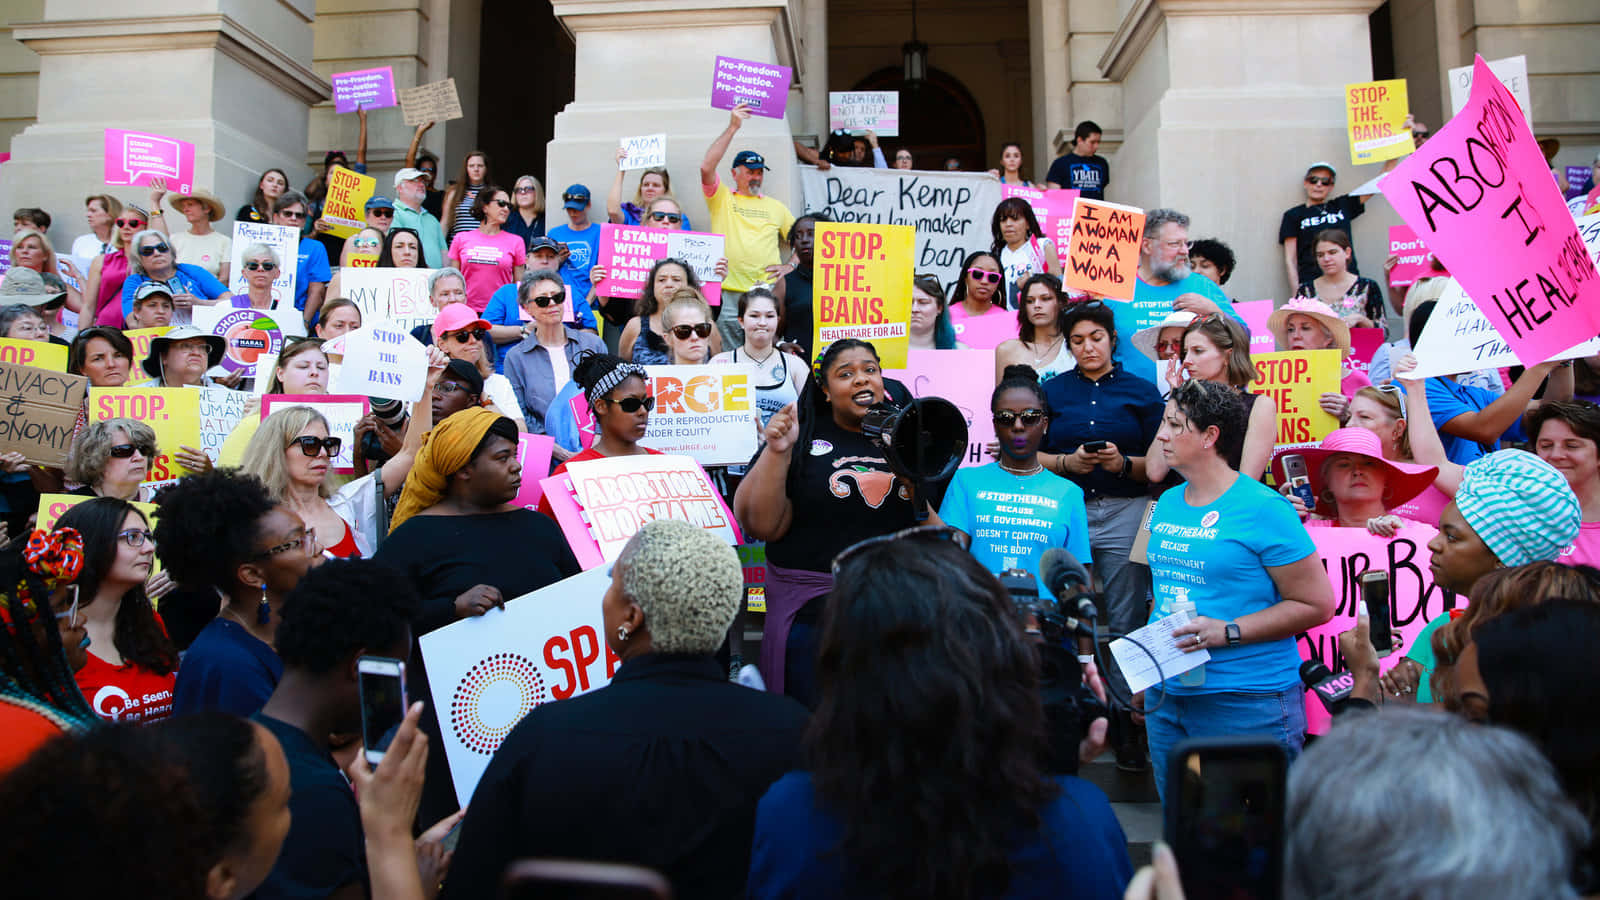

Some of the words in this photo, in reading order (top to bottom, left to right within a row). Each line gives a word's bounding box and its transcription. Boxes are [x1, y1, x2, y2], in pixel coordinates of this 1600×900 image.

[719, 60, 783, 79] Pro-Freedom.
[717, 70, 776, 88] Pro-Justice.
[715, 82, 771, 98] Pro-Choice.
[1350, 86, 1390, 105] STOP.
[1352, 105, 1383, 123] THE.
[1353, 122, 1397, 141] BANS.
[627, 137, 660, 151] MOM
[1411, 85, 1518, 233] ABORTION
[334, 171, 361, 192] STOP.
[331, 186, 352, 205] THE.
[827, 177, 875, 208] Dear
[899, 177, 971, 216] Kemp
[326, 201, 359, 222] BANS.
[1080, 205, 1099, 221] I
[1109, 210, 1132, 227] AM
[614, 229, 619, 240] I
[622, 230, 668, 244] STAND
[1073, 222, 1083, 236] A
[1085, 222, 1139, 243] WOMAN
[613, 242, 651, 257] WITH
[821, 231, 886, 262] STOP.
[1106, 244, 1120, 262] A
[1391, 239, 1426, 252] Don't
[612, 256, 657, 271] PLANN
[611, 270, 650, 281] PARE
[820, 263, 871, 293] THE.
[350, 288, 377, 315] MY
[820, 295, 889, 325] BANS.
[215, 311, 257, 336] CHOICE
[373, 329, 405, 345] STOP
[821, 328, 872, 341] HEALTHCARE
[873, 326, 889, 337] FOR
[890, 325, 905, 336] ALL
[1250, 336, 1274, 344] are.
[379, 352, 399, 364] THE
[368, 369, 402, 385] BANS
[1254, 358, 1311, 386] STOP.
[0, 367, 79, 403] RIVACY
[98, 394, 169, 421] STOP.
[655, 418, 674, 426] FOR
[676, 414, 750, 425] REPRODUCTIVE
[0, 419, 74, 449] ONOMY
[647, 429, 673, 438] NDER
[675, 427, 712, 438] EQUITY
[584, 470, 713, 509] ABORTION:
[976, 490, 1059, 510] #STOPTHEBANS
[996, 505, 1035, 515] BECAUSE
[594, 506, 639, 543] NO
[976, 515, 991, 524] THE
[993, 515, 1054, 529] GOVERNMENT
[976, 529, 1010, 540] DOESN'T
[1012, 531, 1049, 544] CONTROL
[990, 544, 1009, 554] THIS
[1010, 546, 1033, 556] BODY
[1160, 540, 1191, 553] BECAUSE
[1157, 554, 1206, 570] GOVERNMENT
[1171, 569, 1207, 585] CONTROL
[1321, 551, 1372, 622] UR
[125, 698, 141, 710] Be
[142, 690, 173, 705] Seen.
[144, 704, 174, 717] Hear
